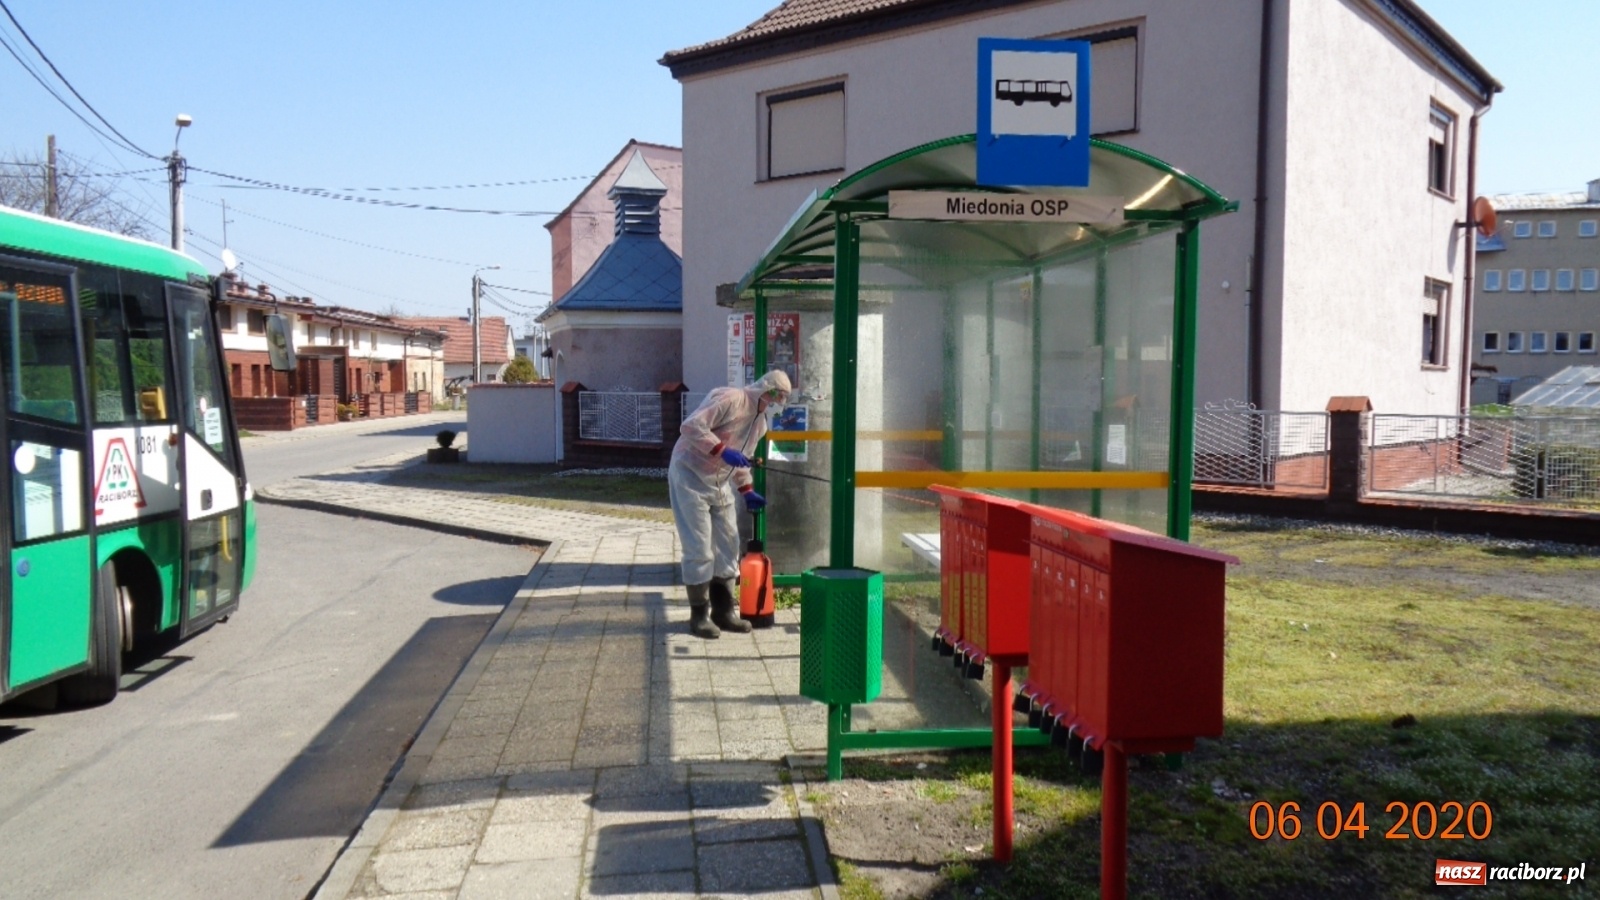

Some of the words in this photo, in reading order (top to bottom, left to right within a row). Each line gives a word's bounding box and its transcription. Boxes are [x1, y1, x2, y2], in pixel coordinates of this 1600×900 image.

[946, 197, 1025, 216] Miedonia
[1030, 198, 1069, 216] OSP
[136, 435, 157, 455] 1081
[112, 464, 123, 479] PK
[99, 489, 139, 503] RACIBORZ
